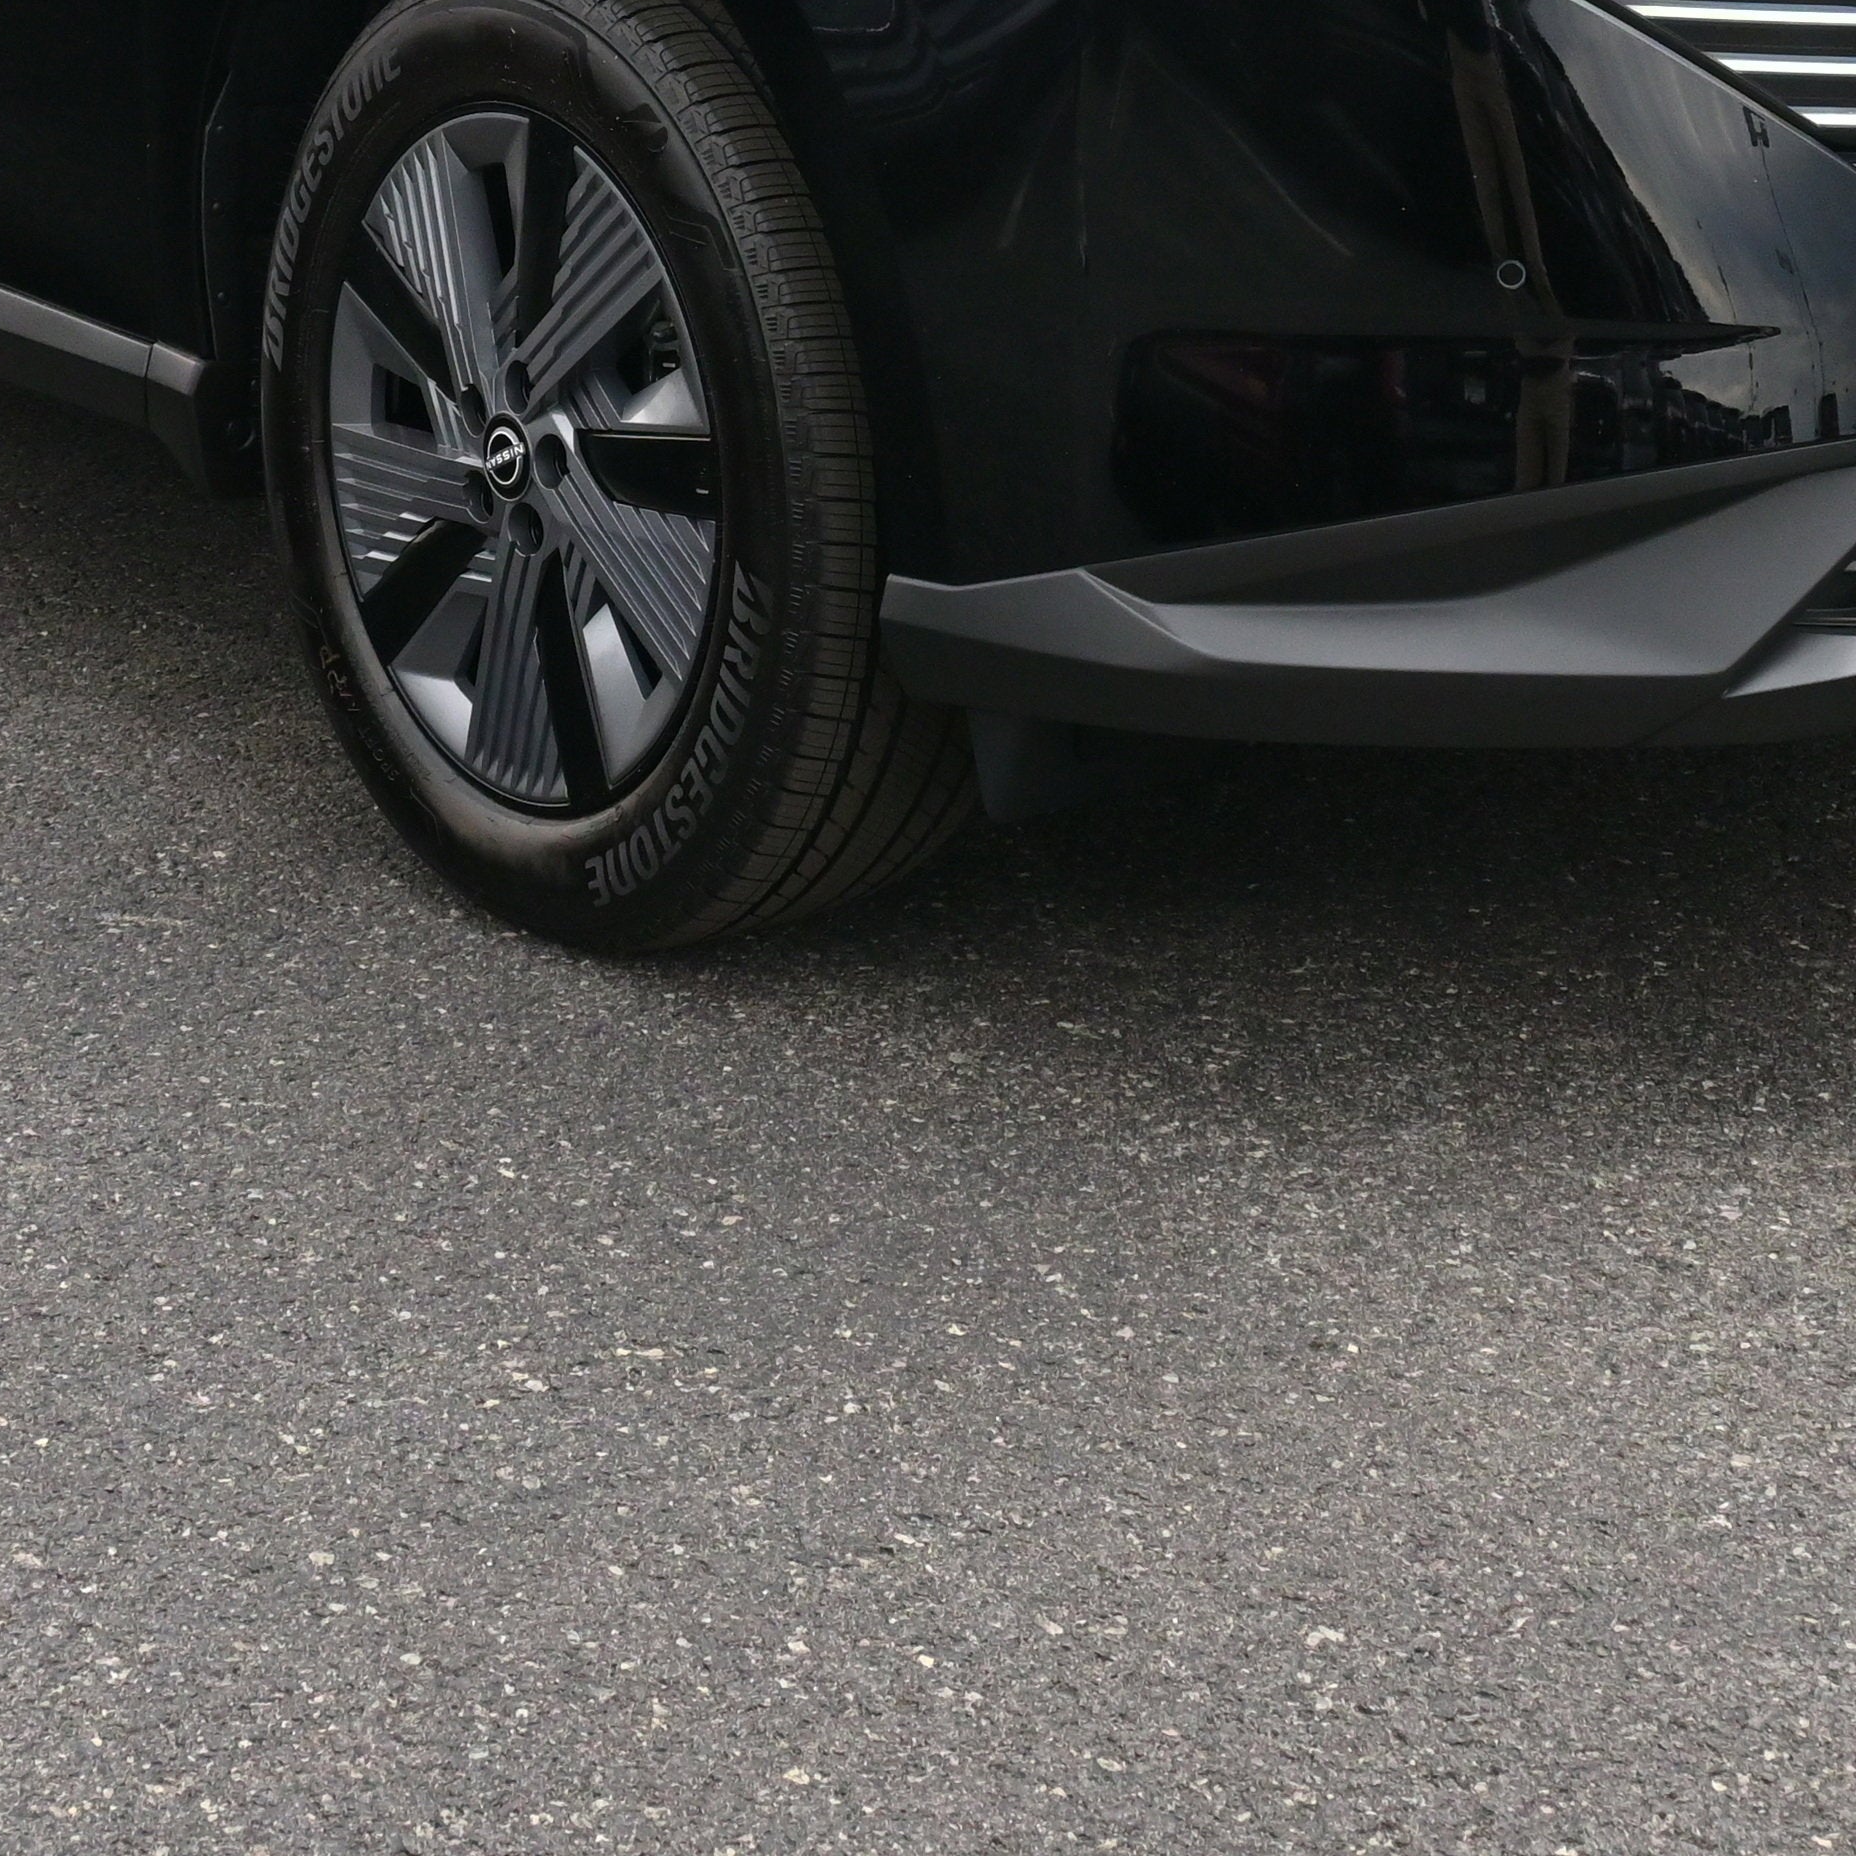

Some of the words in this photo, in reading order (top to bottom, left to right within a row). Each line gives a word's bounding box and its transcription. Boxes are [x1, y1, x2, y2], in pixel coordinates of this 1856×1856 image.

[263, 46, 402, 374] BRIDGESTONE
[486, 445, 525, 471] NISSAN
[584, 559, 774, 908] BRIDGESTONE
